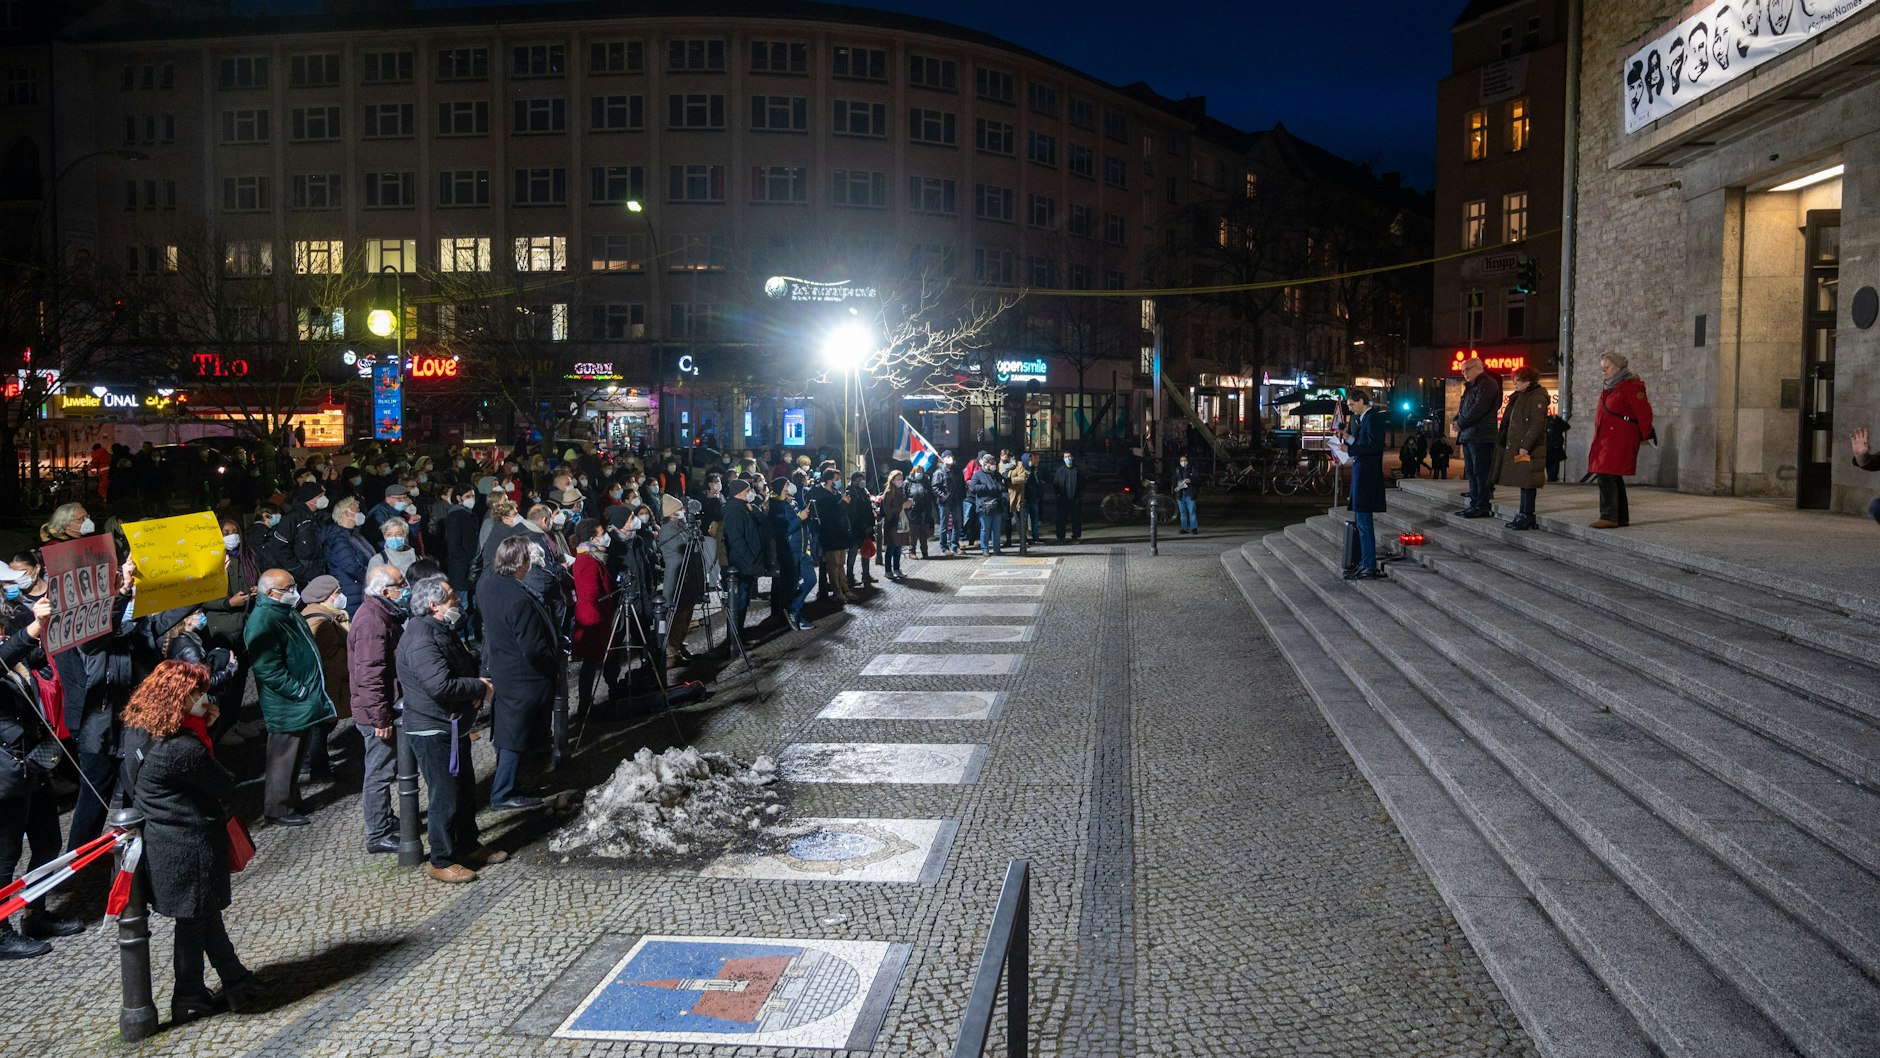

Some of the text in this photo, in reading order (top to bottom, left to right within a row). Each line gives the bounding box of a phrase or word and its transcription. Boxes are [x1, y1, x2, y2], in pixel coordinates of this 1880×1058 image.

[412, 354, 457, 377] Love
[62, 393, 139, 408] Juwelier ÜNAL
